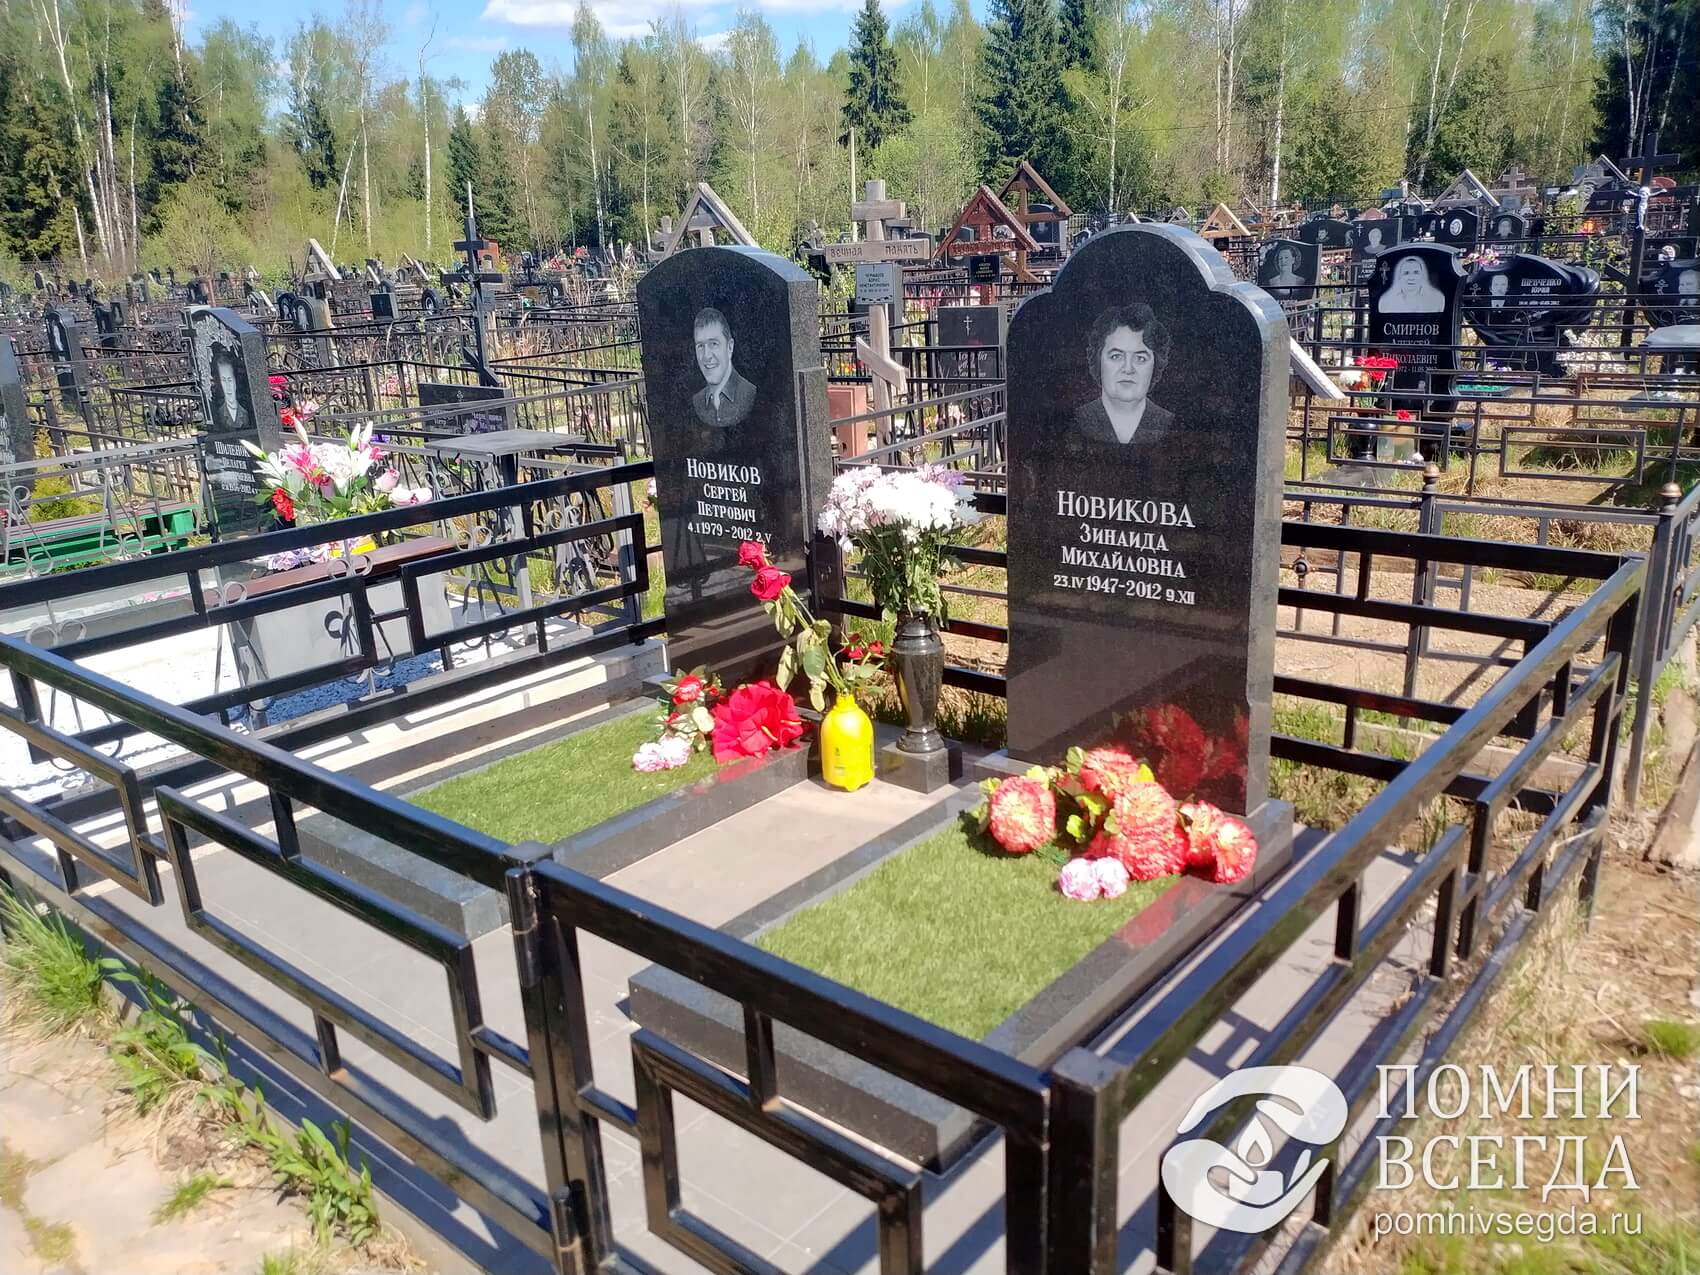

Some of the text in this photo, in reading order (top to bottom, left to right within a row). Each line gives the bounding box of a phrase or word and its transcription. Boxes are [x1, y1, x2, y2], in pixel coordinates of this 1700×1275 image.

[1383, 322, 1440, 336] СМИРНОВ
[686, 457, 761, 485] НОВИКОВ
[703, 483, 748, 503] СЕРГЕЙ
[697, 500, 757, 523] ПЕТРОВИЧ
[1056, 490, 1196, 528] НОВИКОВА
[1079, 521, 1169, 553] ЗИНАИДА
[1061, 545, 1187, 579] МИХАЙЛОВНА
